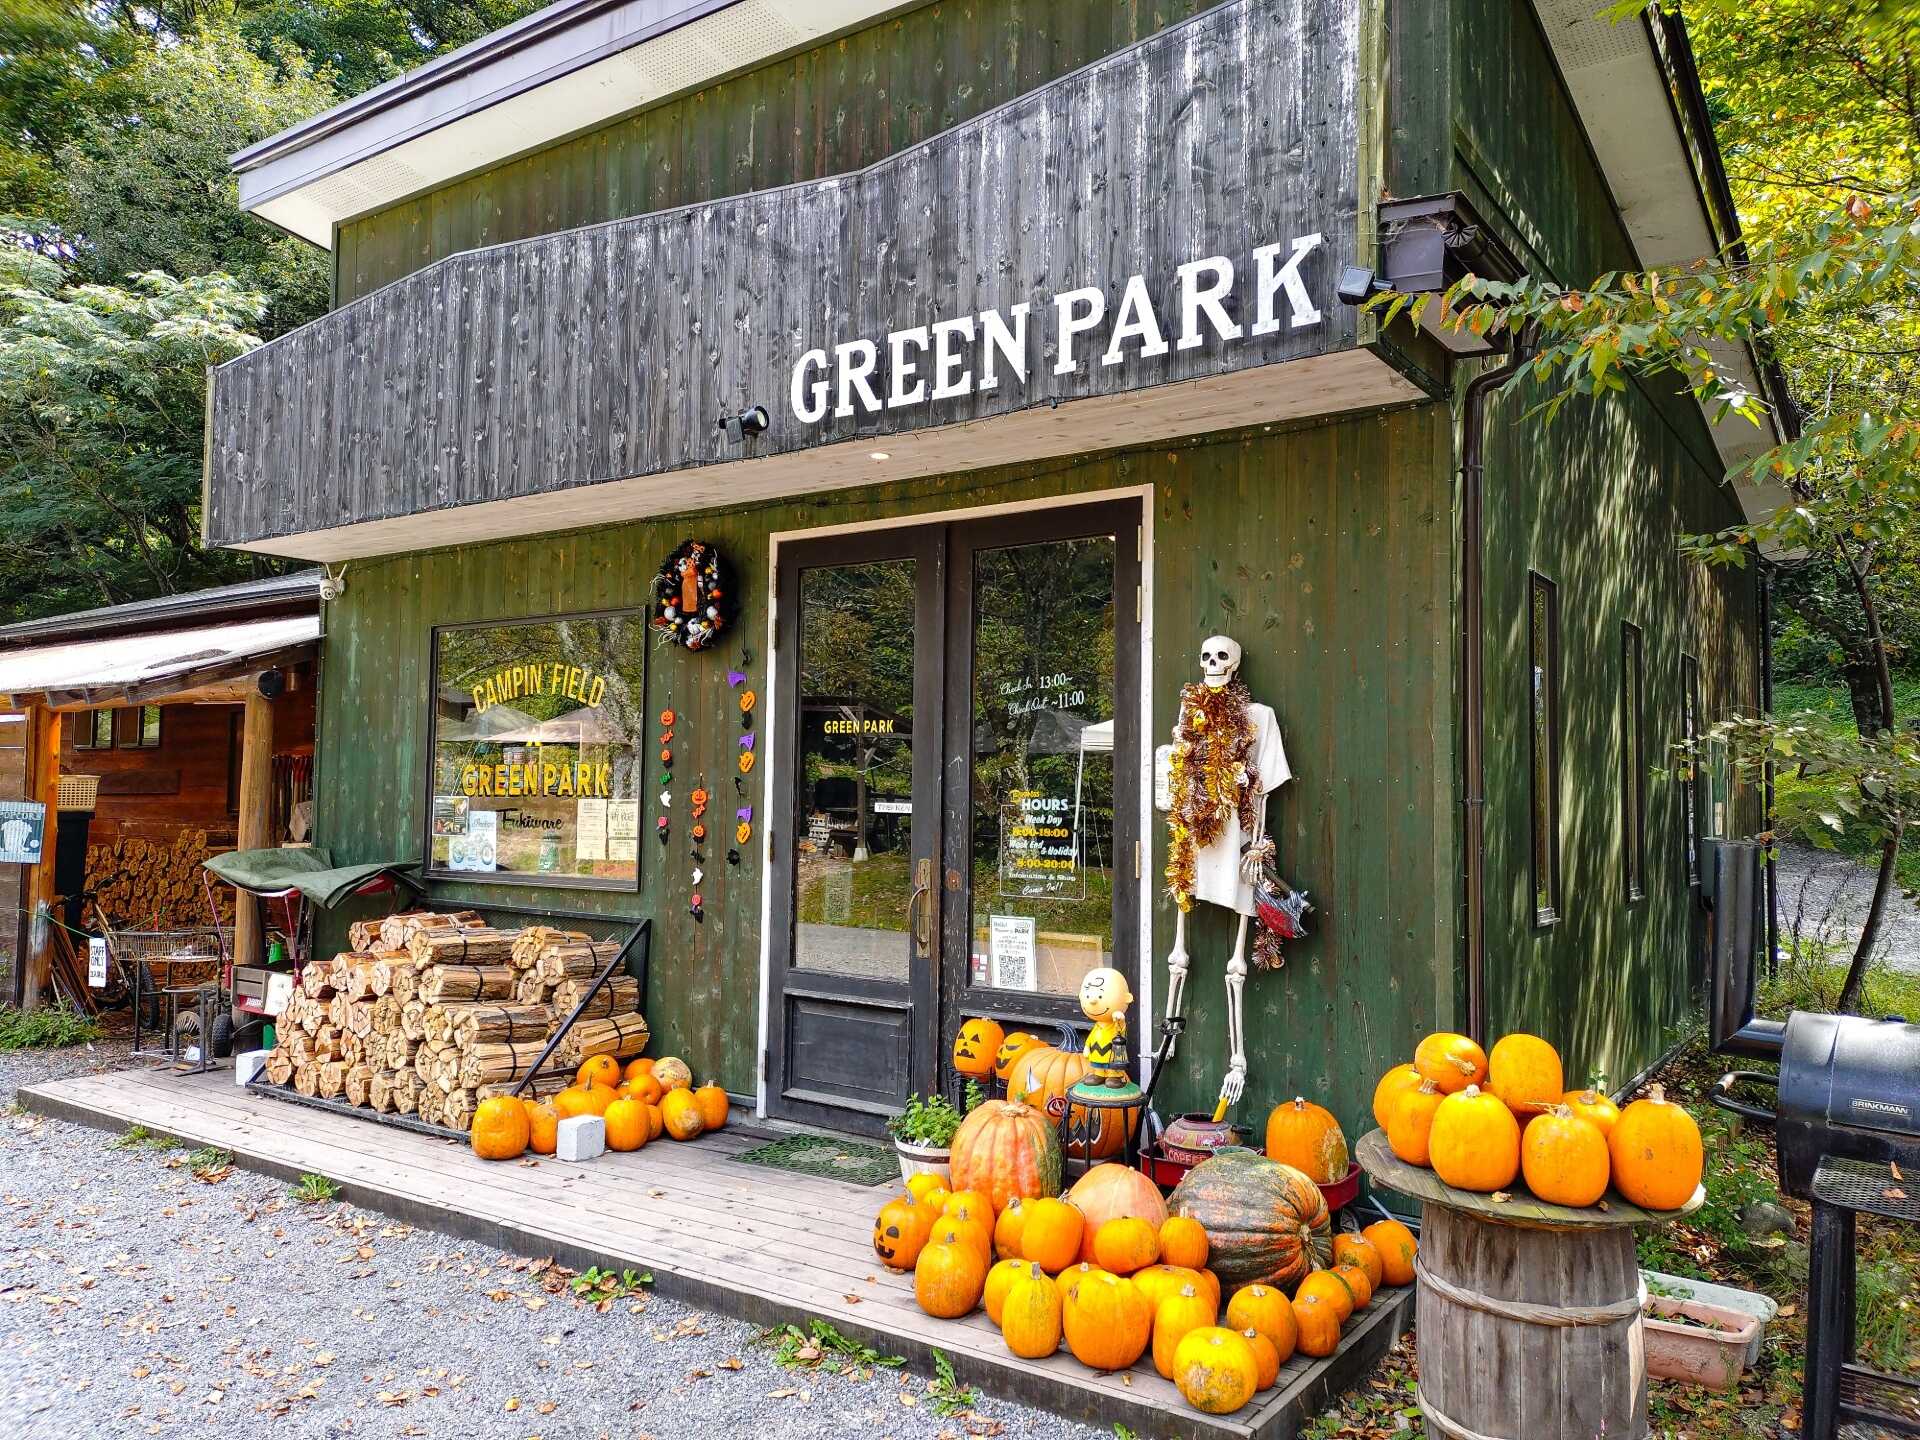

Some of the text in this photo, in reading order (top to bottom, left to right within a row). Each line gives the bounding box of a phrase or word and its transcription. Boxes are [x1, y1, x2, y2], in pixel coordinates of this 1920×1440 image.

[790, 233, 1322, 423] GREEN PARK
[551, 663, 606, 709] FIELD
[824, 720, 894, 734] GREEN PARK
[461, 763, 609, 798] GREEN PARK
[1021, 798, 1069, 811] HOURS
[496, 807, 562, 831] Fukiware
[1046, 815, 1063, 827] Day
[1029, 840, 1044, 849] End
[1851, 1100, 1908, 1115] BRINKMANN
